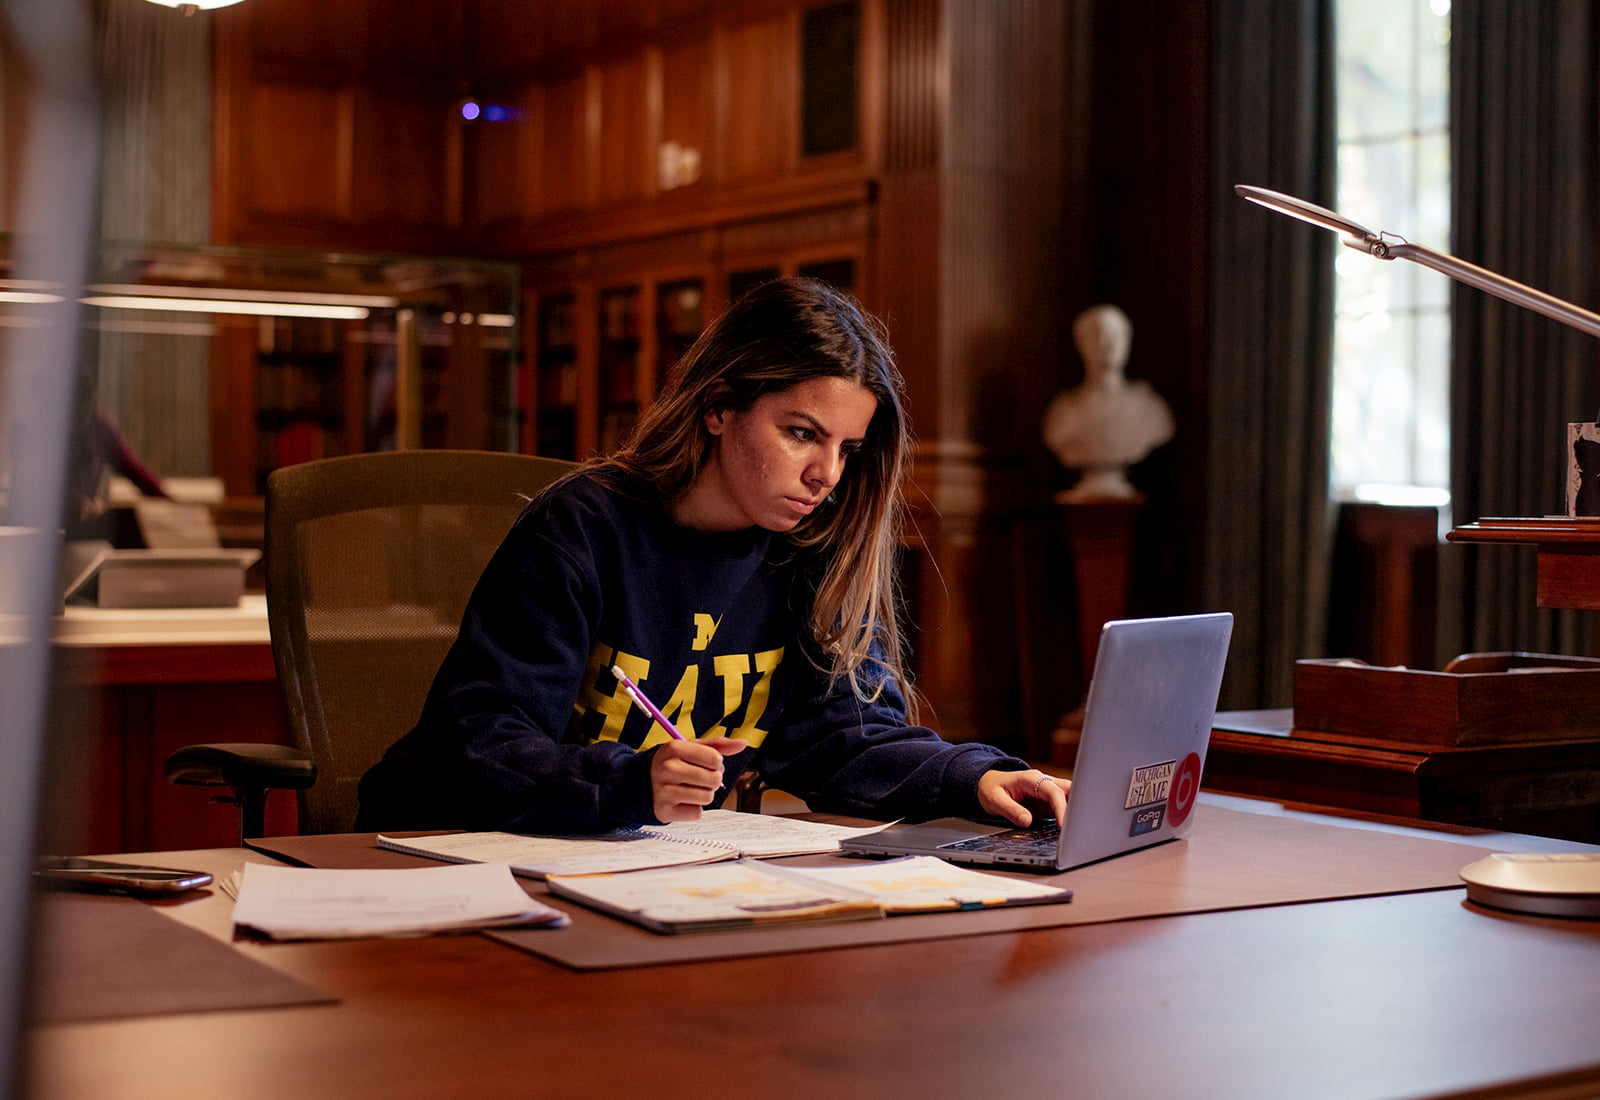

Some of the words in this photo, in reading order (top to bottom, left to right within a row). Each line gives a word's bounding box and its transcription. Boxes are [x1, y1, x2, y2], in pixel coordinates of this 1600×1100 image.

[1135, 763, 1172, 783] MICHIGAN
[1137, 780, 1168, 804] HME
[1137, 811, 1161, 823] GoPro
